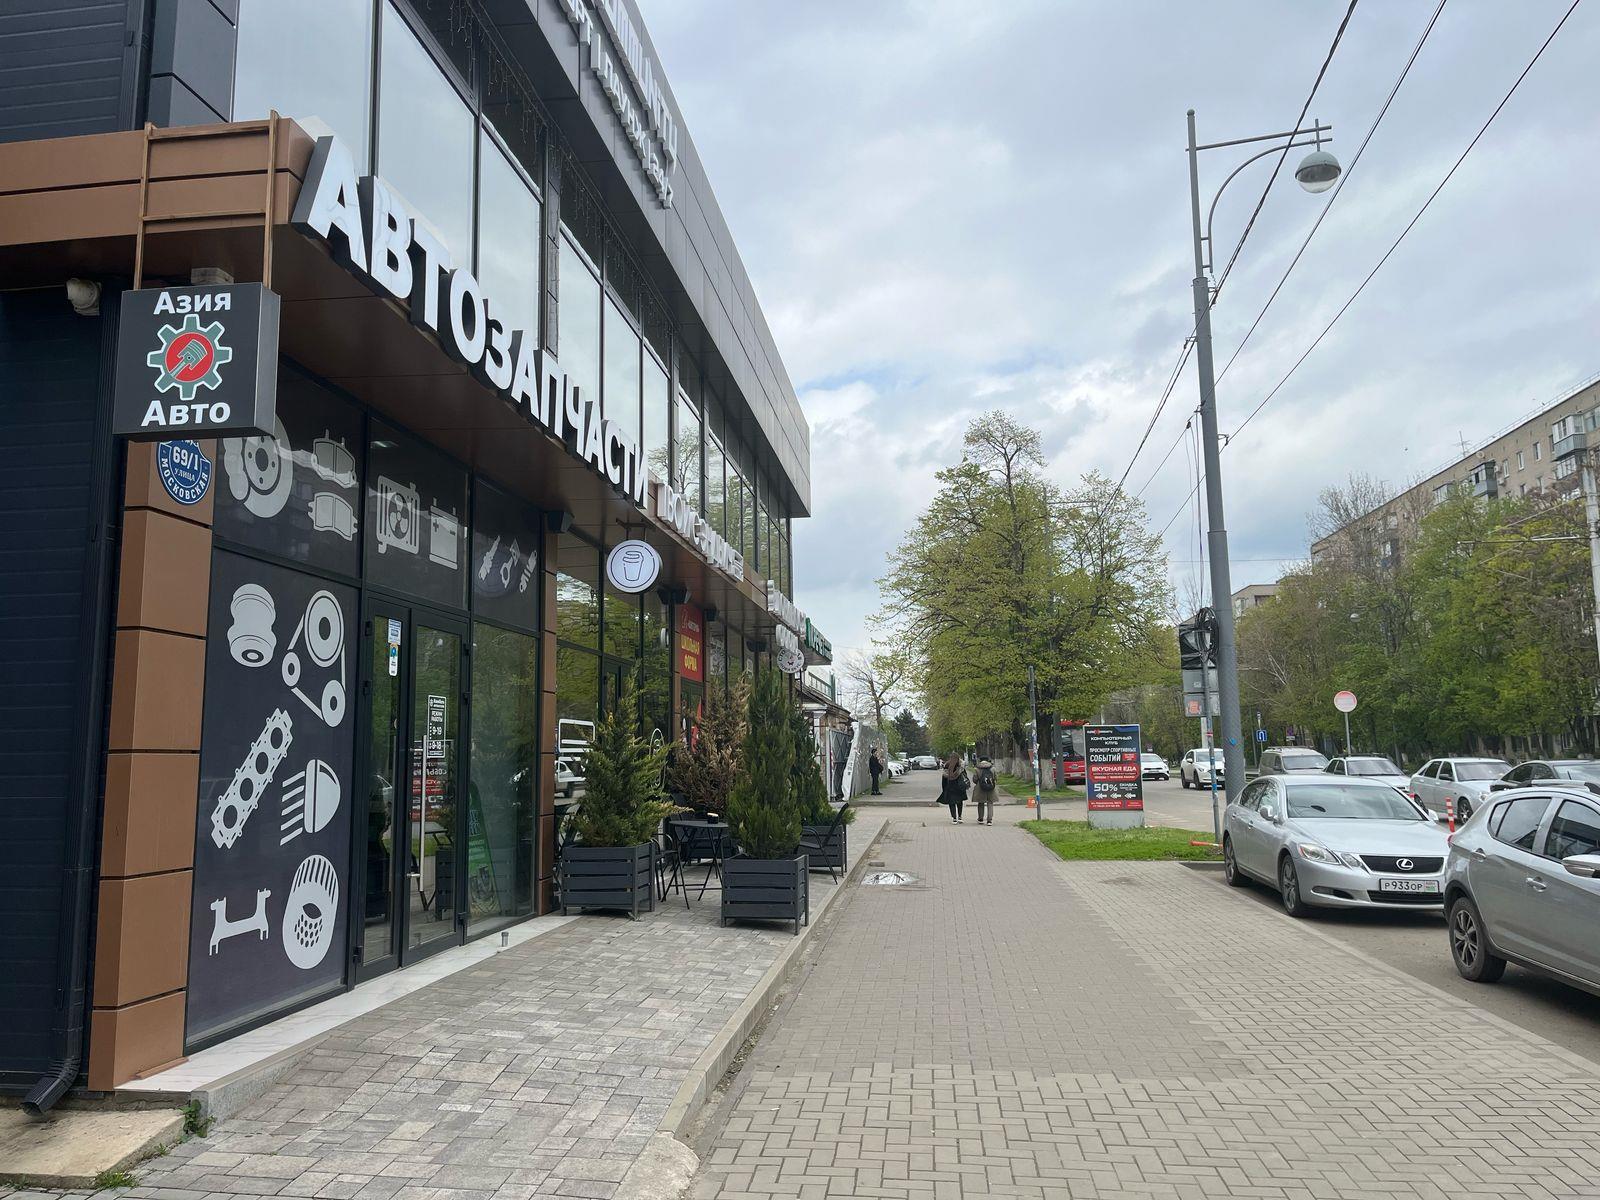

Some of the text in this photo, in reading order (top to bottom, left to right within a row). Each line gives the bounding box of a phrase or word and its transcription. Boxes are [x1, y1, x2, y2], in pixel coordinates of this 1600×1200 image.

[153, 291, 231, 315] Азия
[302, 135, 649, 509] АВТОЗАПЧАСТИ
[141, 400, 231, 427] Авто
[173, 446, 199, 471] 69/1
[161, 457, 208, 500] МОСКОВСКАЯ
[174, 467, 196, 482] УЛИЦА
[1090, 753, 1121, 762] СОБЫТИЙ
[1093, 783, 1118, 792] 50%
